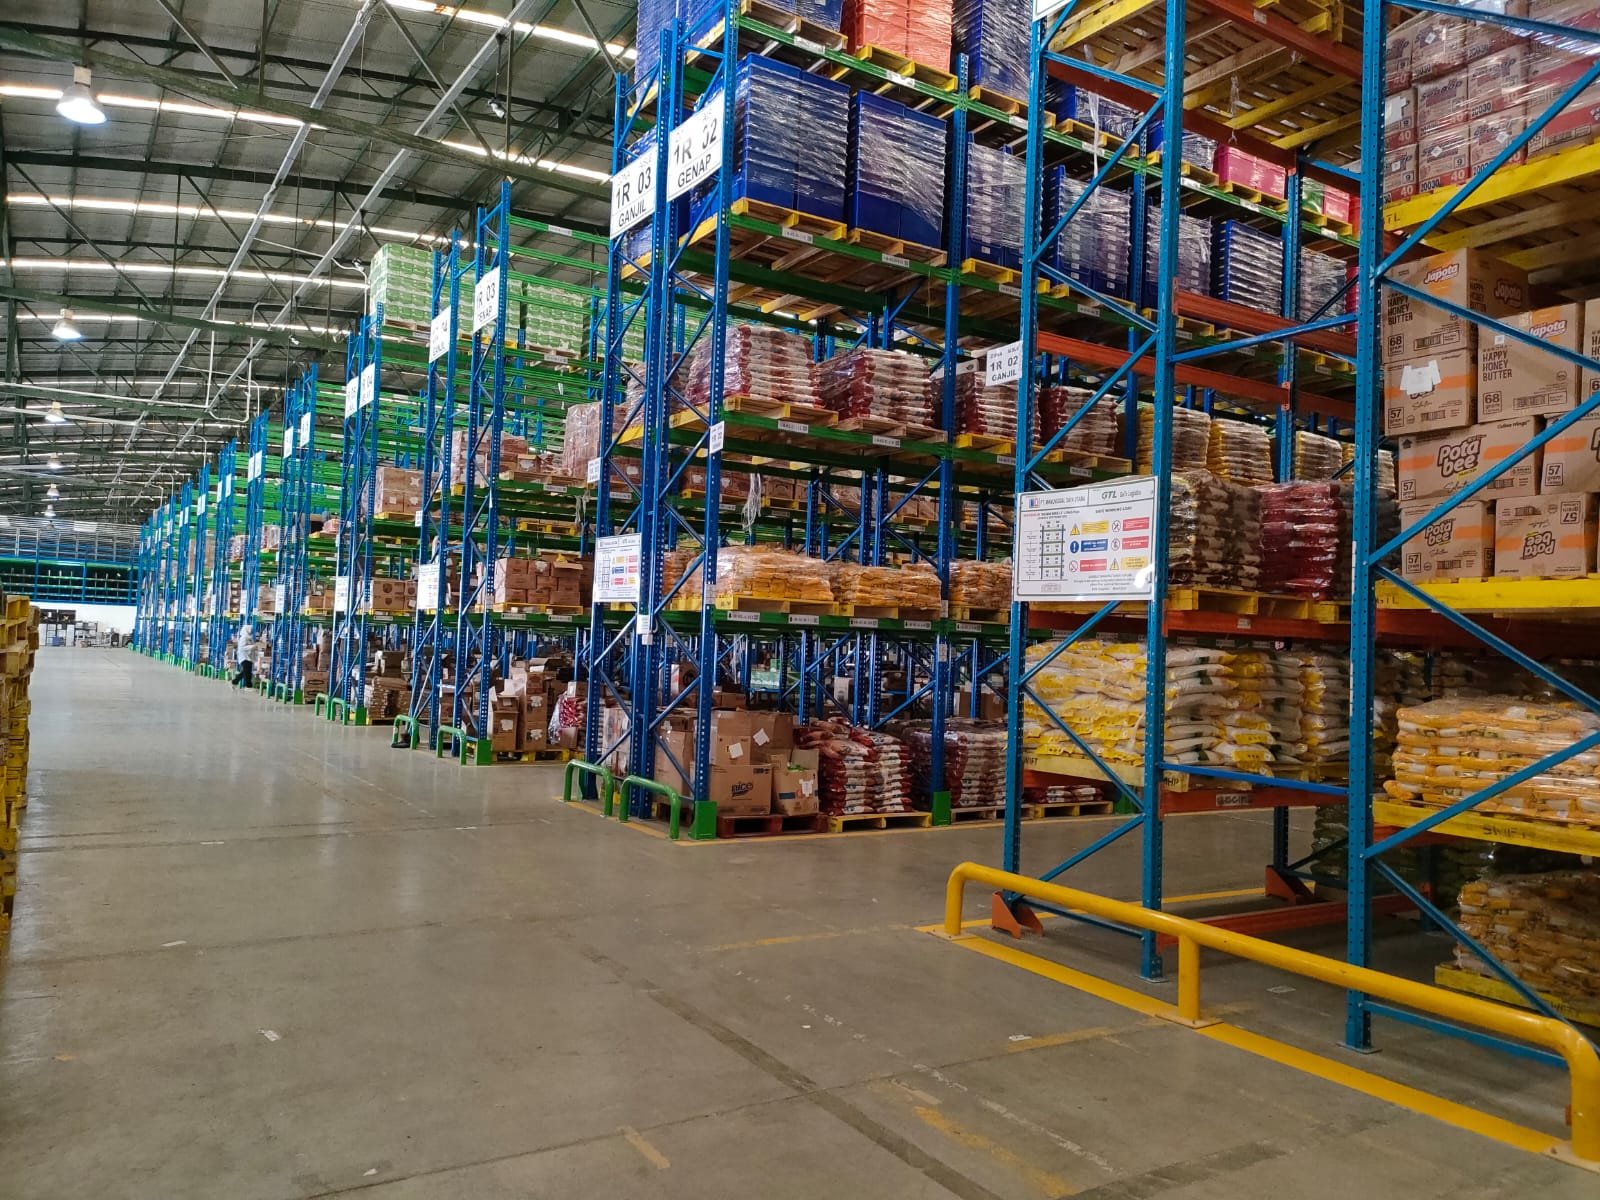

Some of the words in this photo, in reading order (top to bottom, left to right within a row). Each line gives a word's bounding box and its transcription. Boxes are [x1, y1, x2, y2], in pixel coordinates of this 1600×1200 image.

[1399, 130, 1412, 140] 40
[1457, 158, 1463, 166] 9
[677, 153, 711, 188] GENAP
[1451, 170, 1465, 181] 40
[616, 182, 630, 209] 1R
[637, 166, 651, 195] 03
[1400, 186, 1413, 197] 40
[1420, 178, 1440, 193] 20030
[618, 199, 647, 227] GANJIL
[1424, 263, 1459, 284] Japota
[1387, 295, 1409, 307] HAPPY
[1388, 303, 1410, 316] HONEY
[1388, 312, 1413, 326] BUTTER
[1389, 335, 1402, 346] 68
[1483, 350, 1508, 362] HAPPY
[990, 360, 1002, 371] 1R
[1007, 355, 1018, 367] 02
[1483, 359, 1509, 372] HONEY
[991, 369, 1017, 382] GANJIL
[1483, 368, 1513, 382] BUTTER
[1591, 380, 1600, 391] 6
[1484, 393, 1500, 404] 68
[1390, 408, 1402, 419] 57
[1437, 439, 1481, 467] Pota
[1441, 454, 1479, 477] bee
[1548, 465, 1560, 475] 57
[1403, 481, 1414, 491] 57
[1101, 490, 1117, 500] GTL
[1562, 512, 1577, 523] 57
[1424, 519, 1453, 539] Pota
[1427, 532, 1451, 547] bee
[1525, 531, 1553, 547] bee
[1523, 539, 1556, 560] Pota
[1408, 554, 1419, 564] 57
[731, 781, 754, 795] nice
